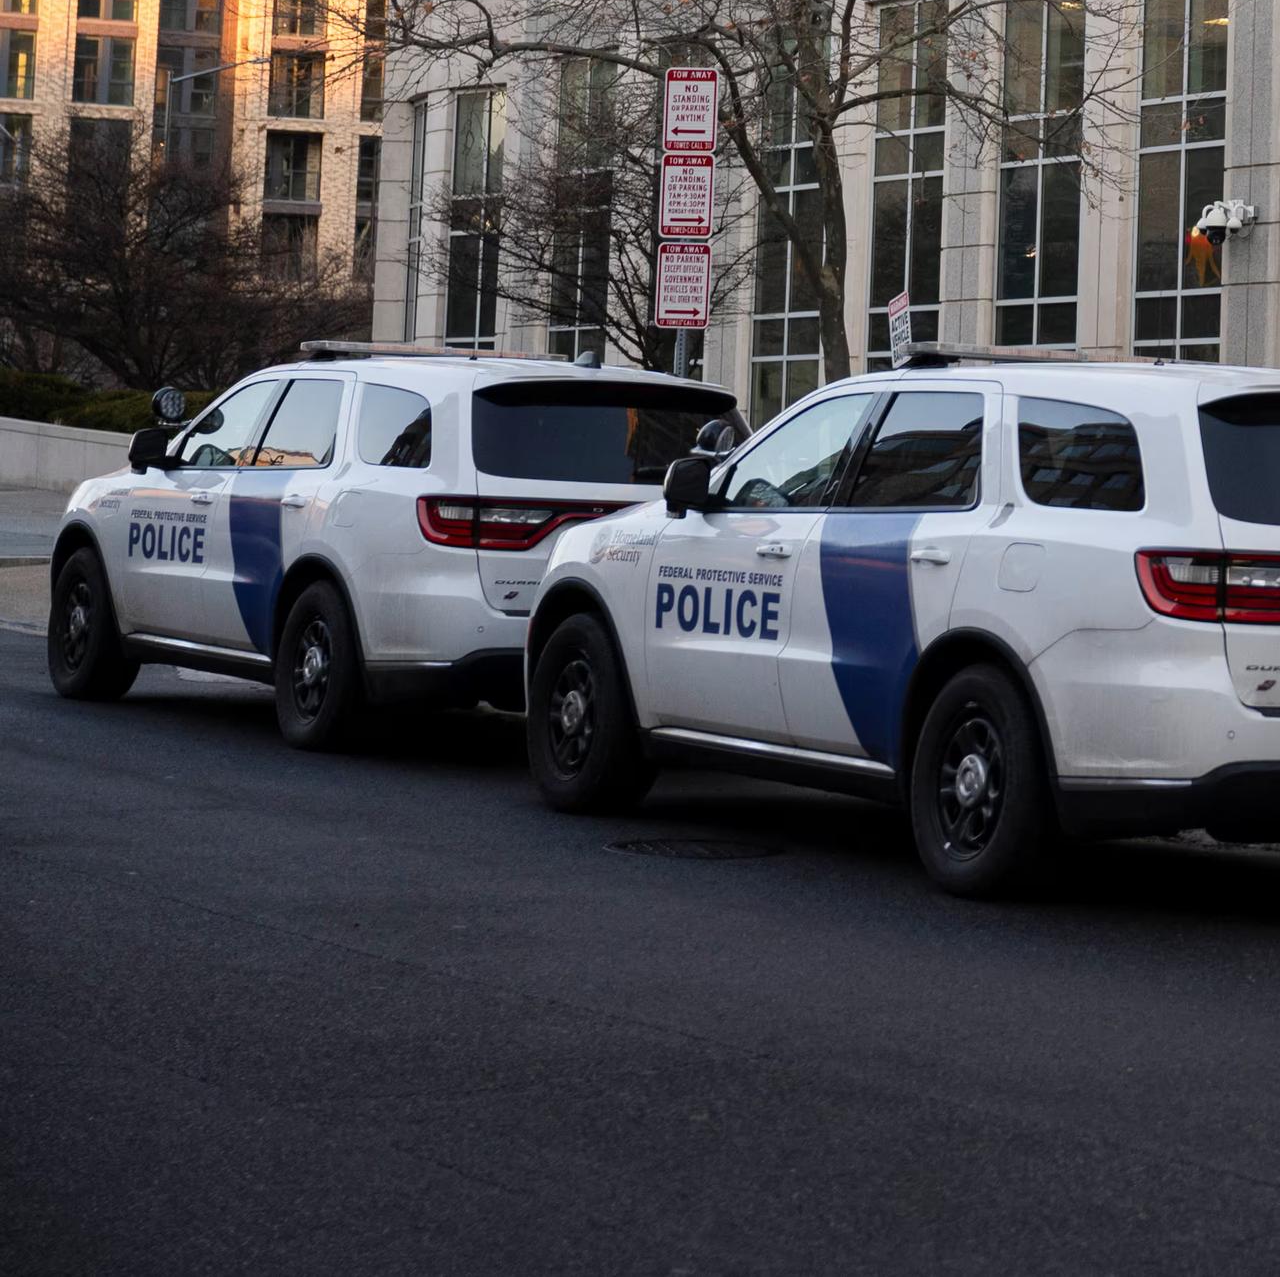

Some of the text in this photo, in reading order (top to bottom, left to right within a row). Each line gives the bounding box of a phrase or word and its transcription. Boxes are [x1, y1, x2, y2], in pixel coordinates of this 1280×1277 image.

[673, 71, 712, 79] TOW AWAY
[673, 95, 710, 103] STANDING
[675, 114, 706, 122] ANYTIME
[686, 157, 707, 165] AWAY
[677, 255, 705, 263] PARKING
[664, 264, 682, 272] EXCEPT
[664, 275, 703, 283] GOVERNMENT
[664, 285, 703, 294] VEHICLES ONLY
[891, 311, 909, 332] ACTIVE
[892, 326, 910, 349] VEHICLE
[154, 510, 185, 522] PROTECTIVE
[128, 522, 205, 564] POLICE
[659, 566, 783, 587] FEDERAL PROTECTIVE SERVICE
[655, 583, 780, 640] POLICE
